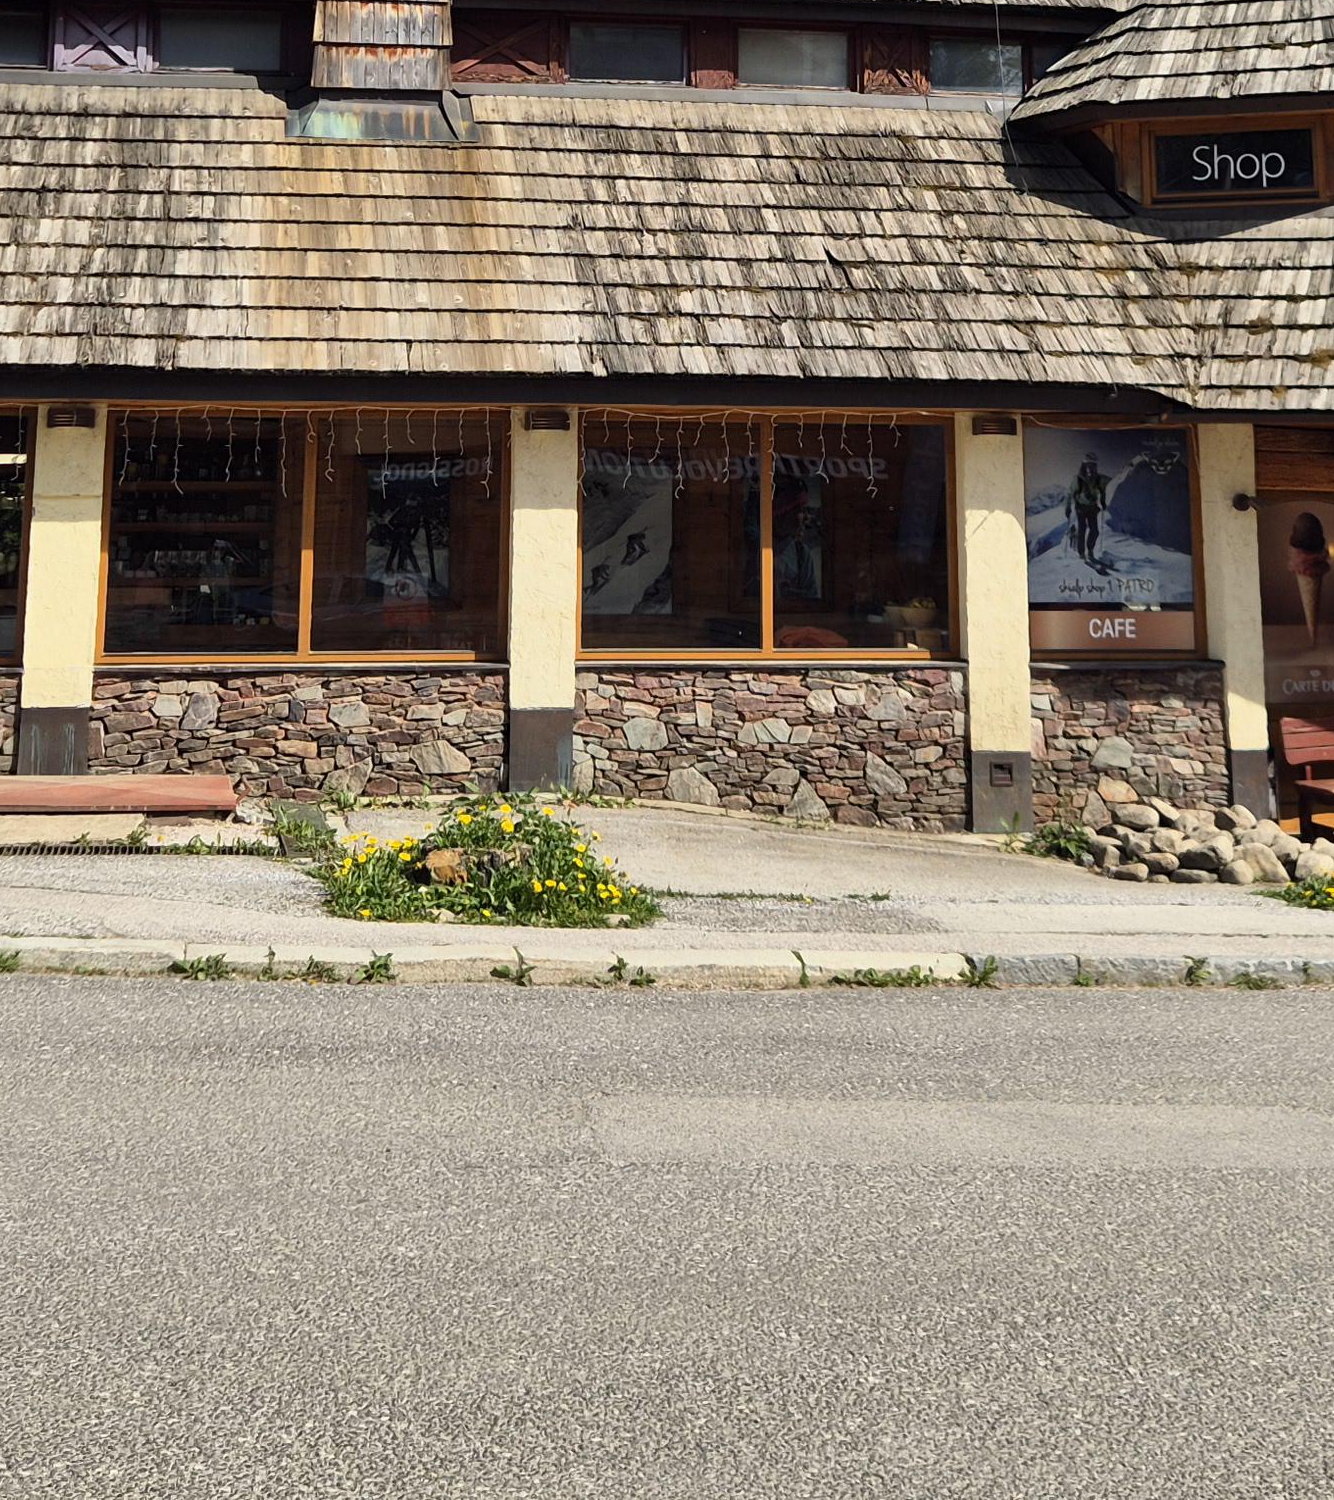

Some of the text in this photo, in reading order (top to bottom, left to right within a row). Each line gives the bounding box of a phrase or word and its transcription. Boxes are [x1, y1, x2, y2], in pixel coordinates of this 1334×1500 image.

[1192, 144, 1286, 188] Shop
[1088, 618, 1136, 638] CAFE
[1282, 678, 1320, 695] CARTE
